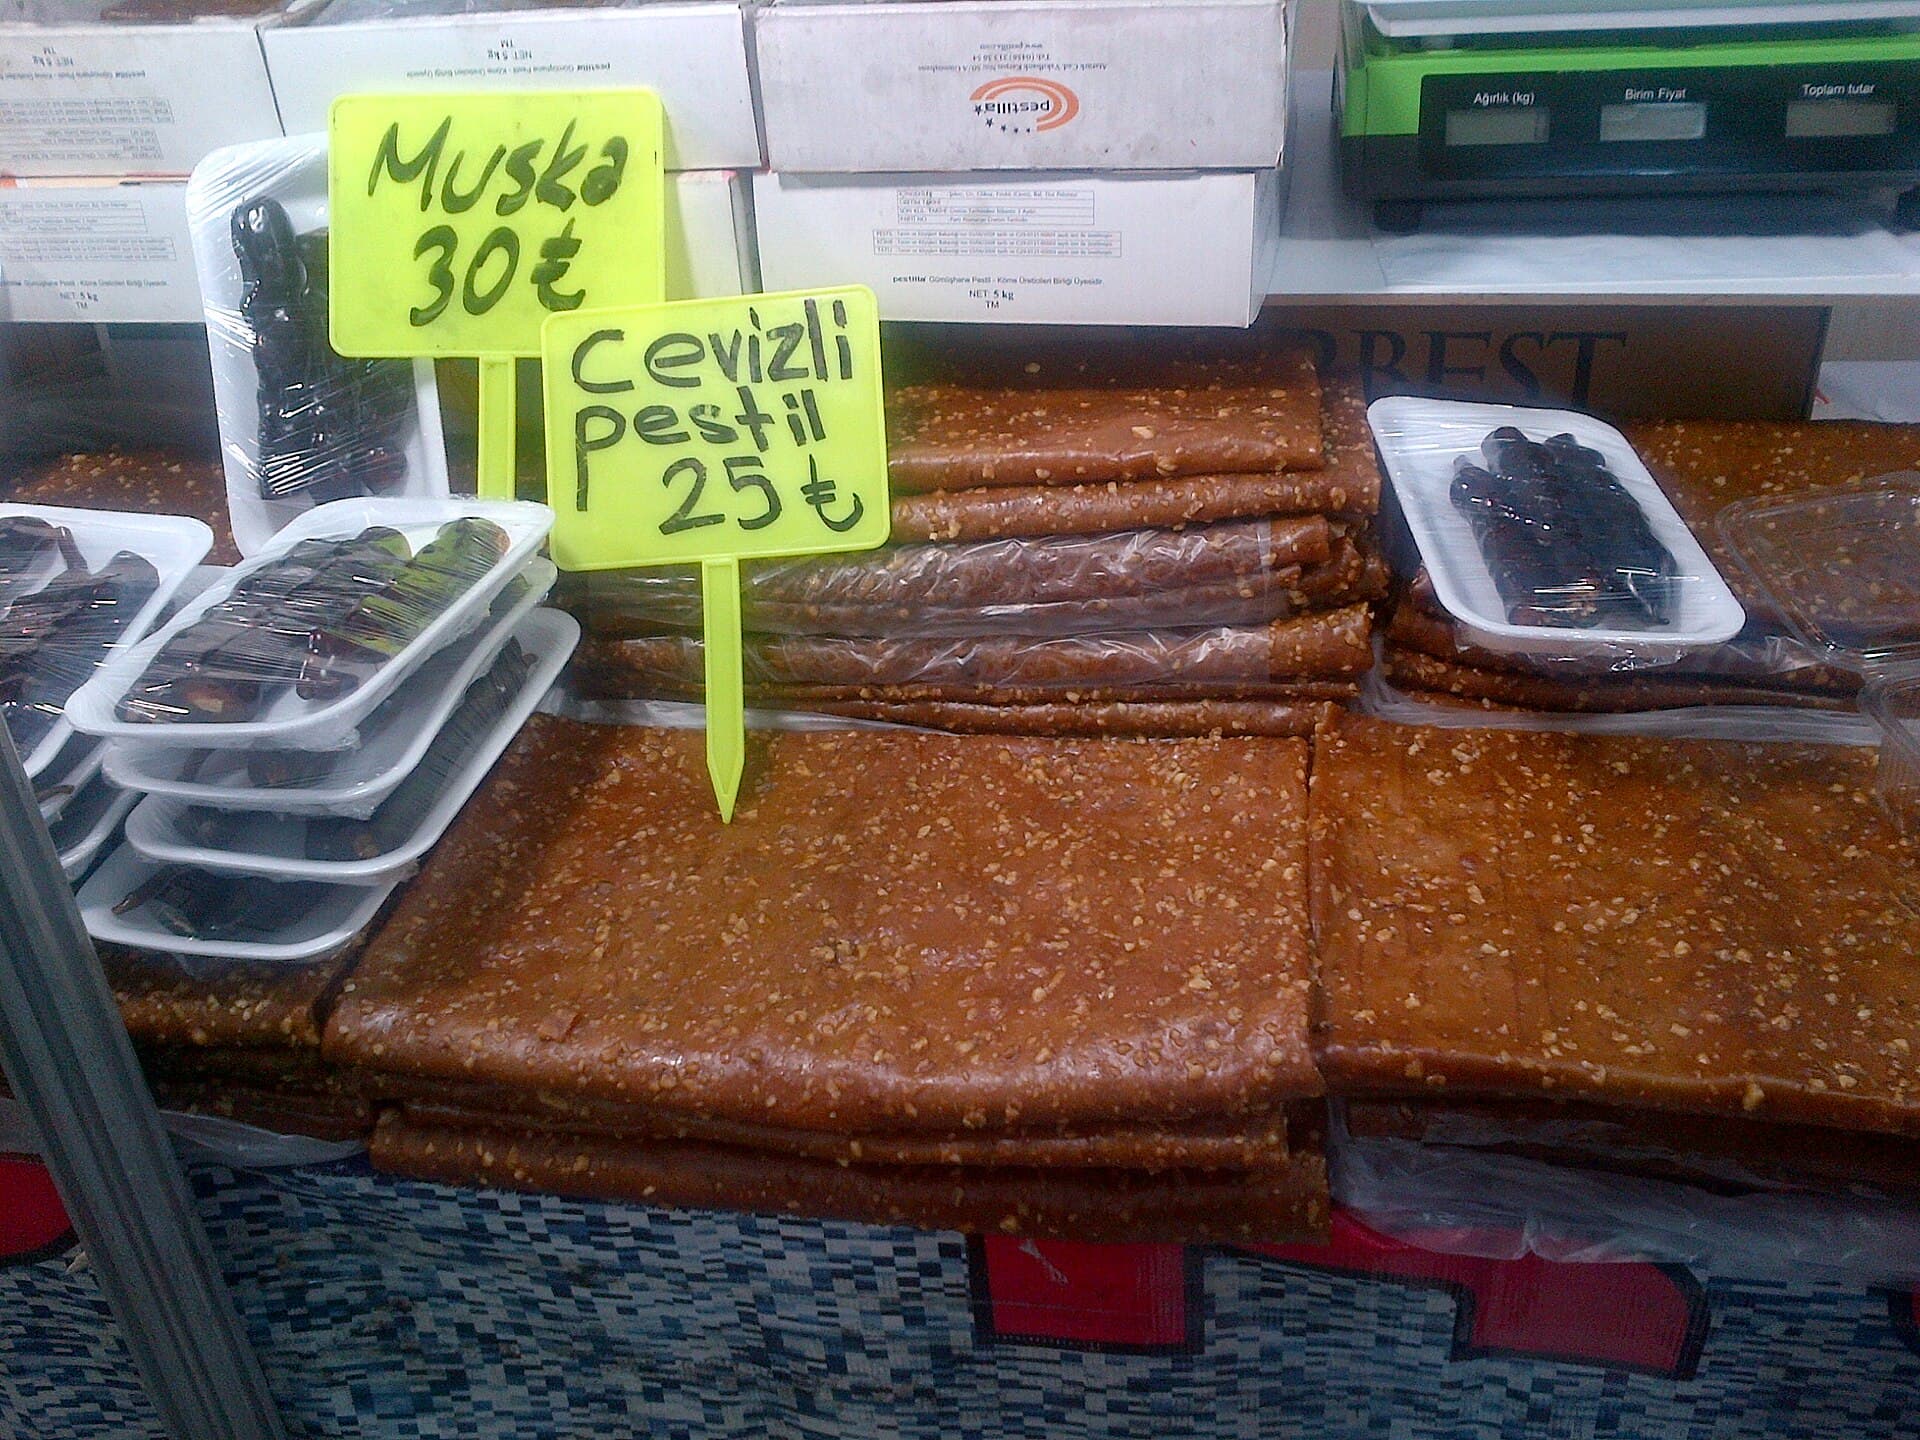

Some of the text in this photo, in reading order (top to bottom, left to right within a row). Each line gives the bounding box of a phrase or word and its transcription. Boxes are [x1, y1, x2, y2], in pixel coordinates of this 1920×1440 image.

[1624, 86, 1687, 101] Birim Fiyat
[1802, 82, 1876, 98] Toplam tutar
[1473, 91, 1535, 105] Ağırlık (kg)
[984, 100, 1050, 115] pestilla
[367, 115, 629, 216] Muska
[1002, 289, 1014, 301] kg
[985, 301, 999, 309] TM
[575, 385, 826, 512] pestil
